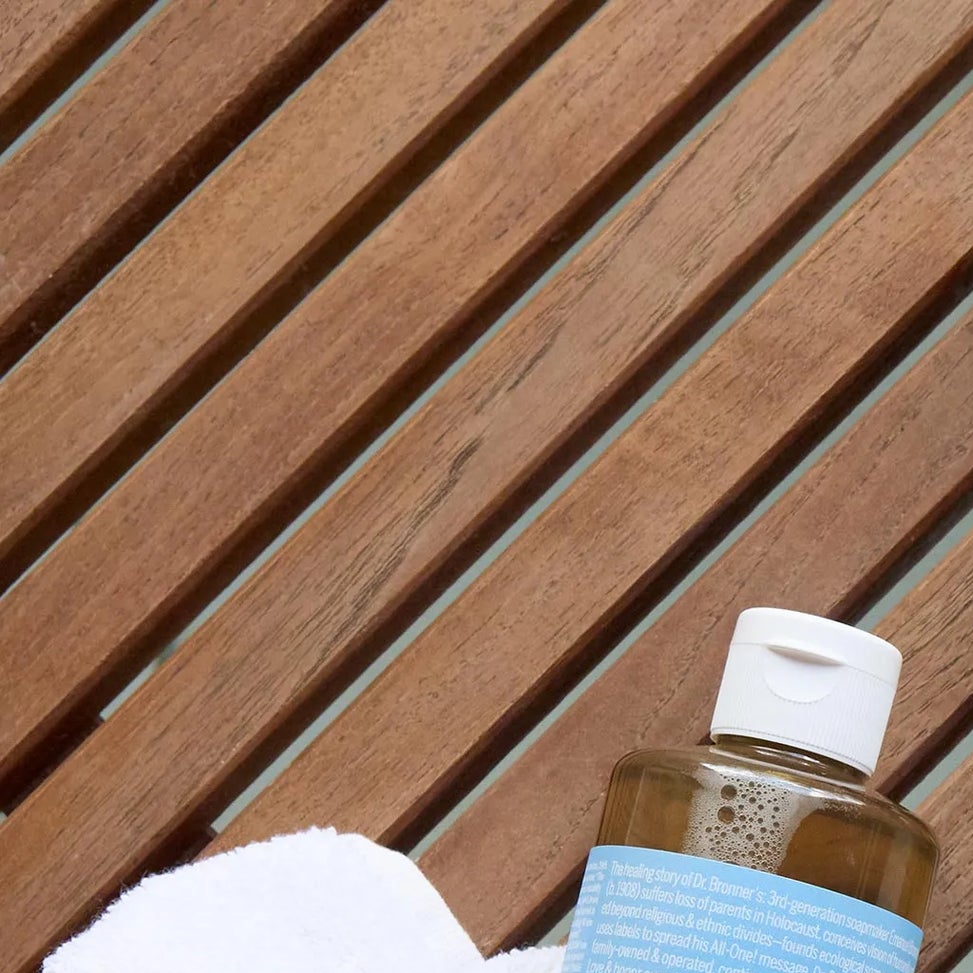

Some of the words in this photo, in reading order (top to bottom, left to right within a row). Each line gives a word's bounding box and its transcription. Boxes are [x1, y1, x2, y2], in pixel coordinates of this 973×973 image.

[653, 866, 680, 887] story
[680, 871, 693, 886] of
[692, 872, 708, 889] Dr.
[607, 900, 642, 920] beyond
[640, 905, 685, 928] religious
[685, 913, 695, 928] &
[695, 916, 732, 936] ethnic
[640, 885, 674, 903] suffers
[674, 890, 694, 907] loss
[696, 895, 709, 910] of
[708, 899, 752, 922] parents
[752, 907, 764, 923] in
[822, 928, 867, 954] conceives
[613, 921, 641, 938] labels
[641, 925, 653, 941] to
[652, 929, 694, 950] spread
[691, 935, 709, 952] his
[709, 939, 757, 963] All-One!
[650, 947, 661, 963] &
